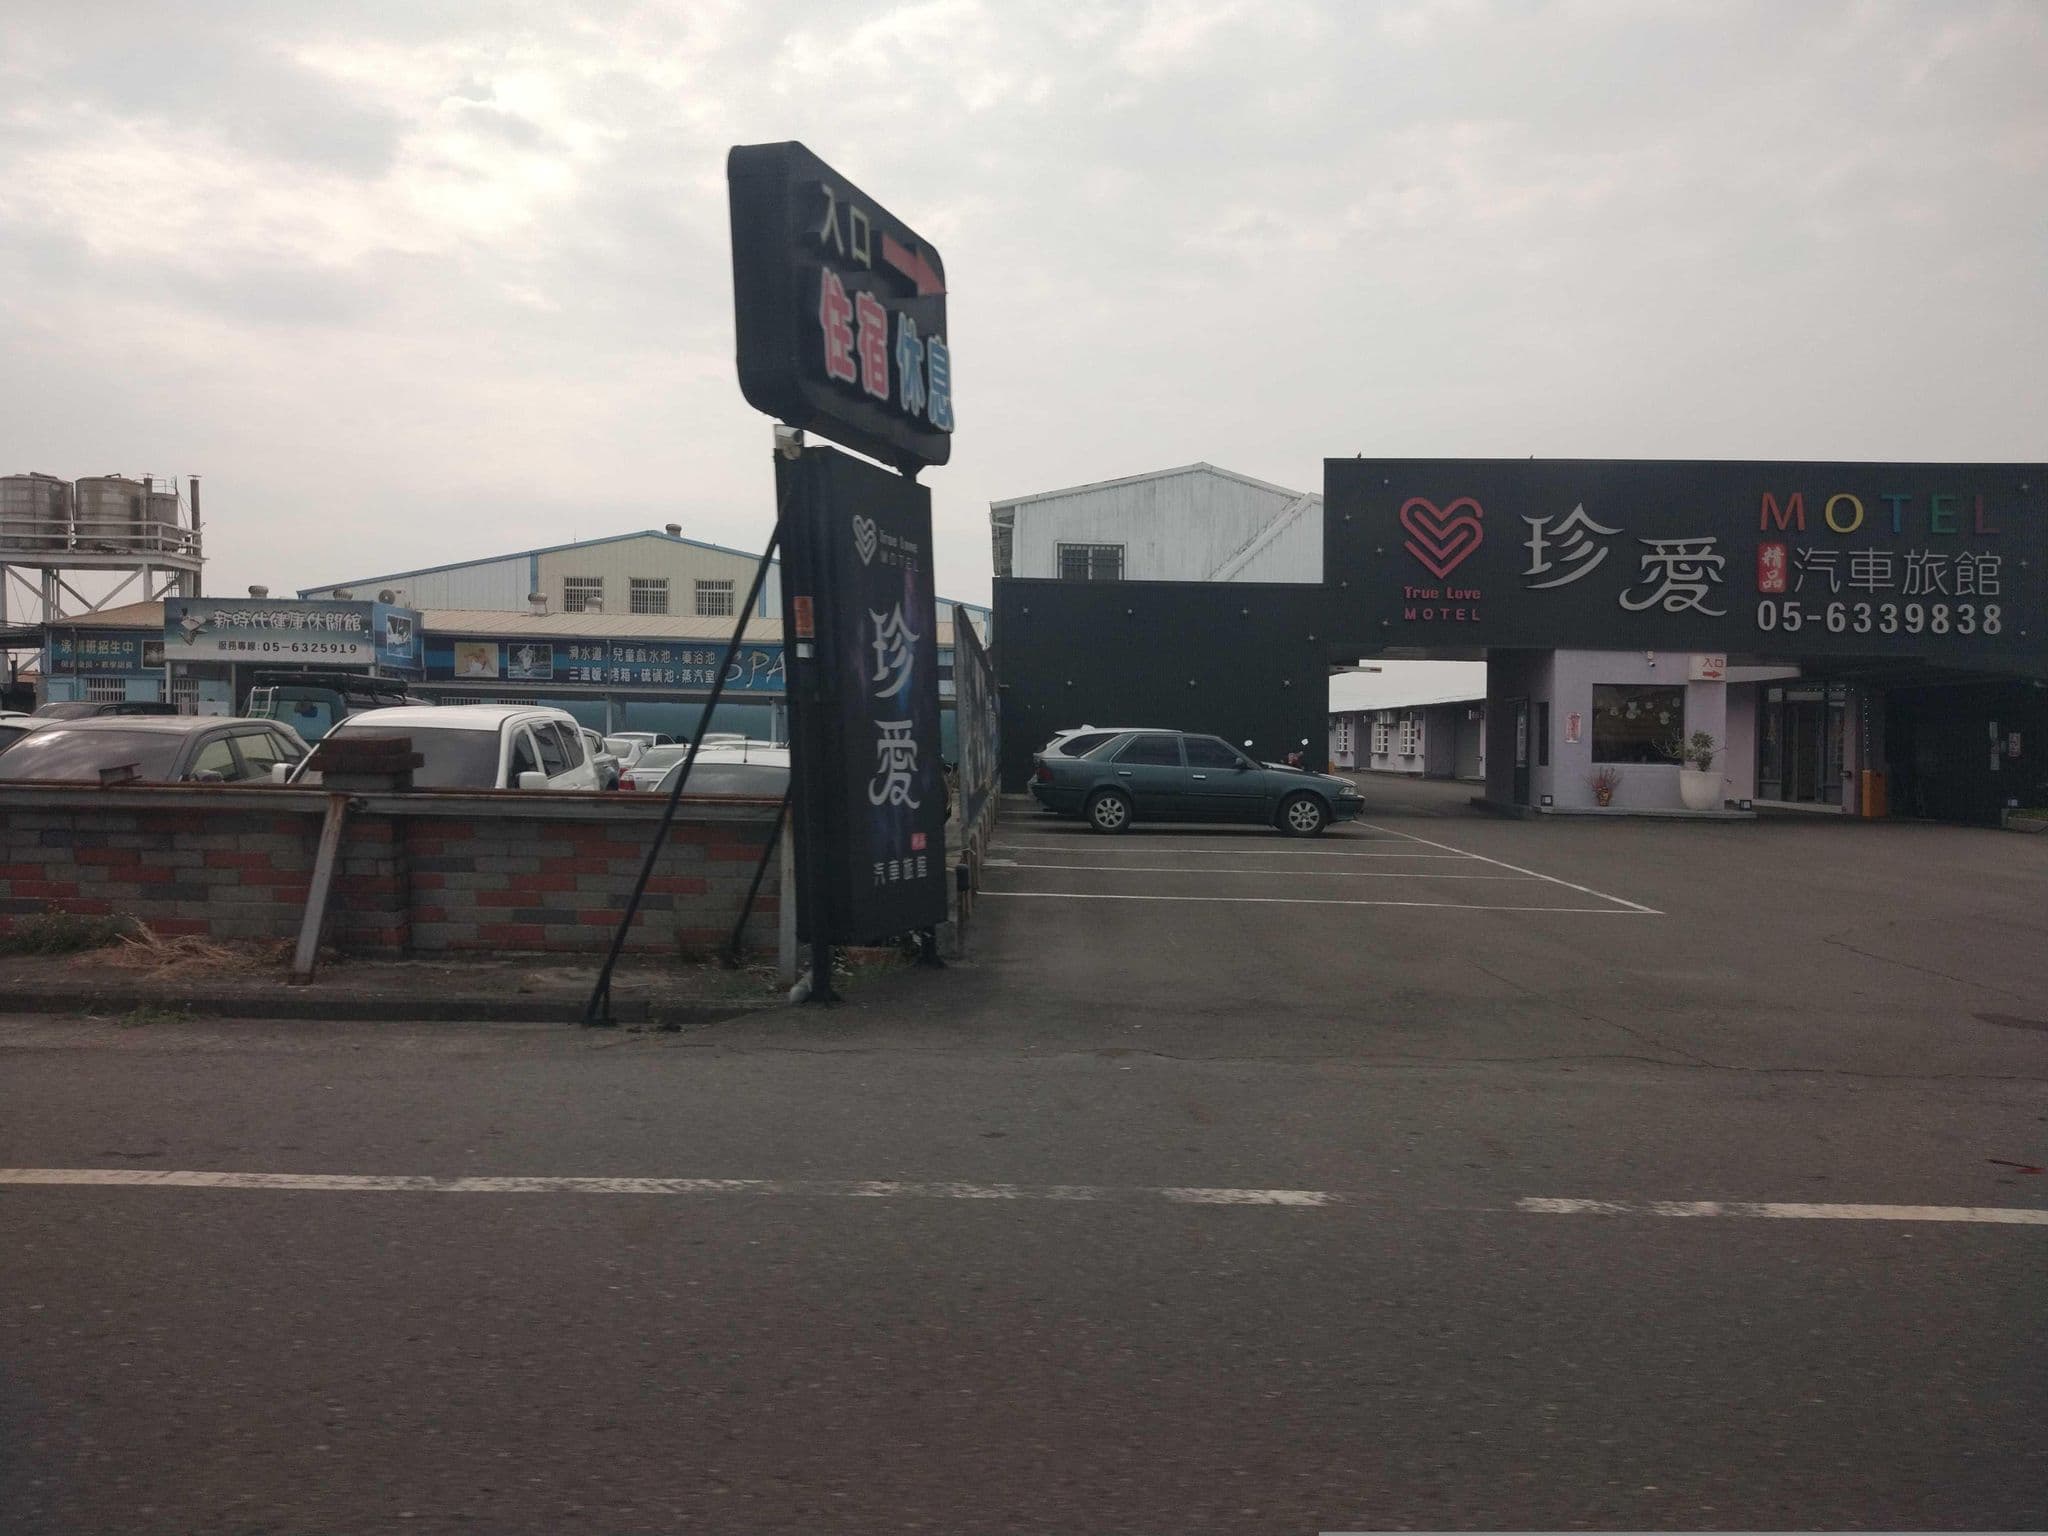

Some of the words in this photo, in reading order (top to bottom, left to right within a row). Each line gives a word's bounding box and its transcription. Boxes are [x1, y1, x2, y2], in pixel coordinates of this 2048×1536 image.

[820, 183, 871, 269] 入口
[819, 267, 889, 400] 住宿
[896, 312, 954, 432] 休息
[1760, 492, 2001, 534] MOTEL
[1520, 502, 1727, 617] 珍愛
[1762, 546, 1784, 589] 精品
[1794, 547, 2002, 596] 汽車旅館
[1404, 586, 1440, 600] True
[1447, 587, 1481, 601] Love
[1404, 607, 1481, 622] MOTEL
[1757, 600, 2001, 635] 05-6339838
[262, 641, 358, 654] 05-6325919
[1702, 657, 1724, 669] 入口
[868, 602, 921, 810] 珍愛
